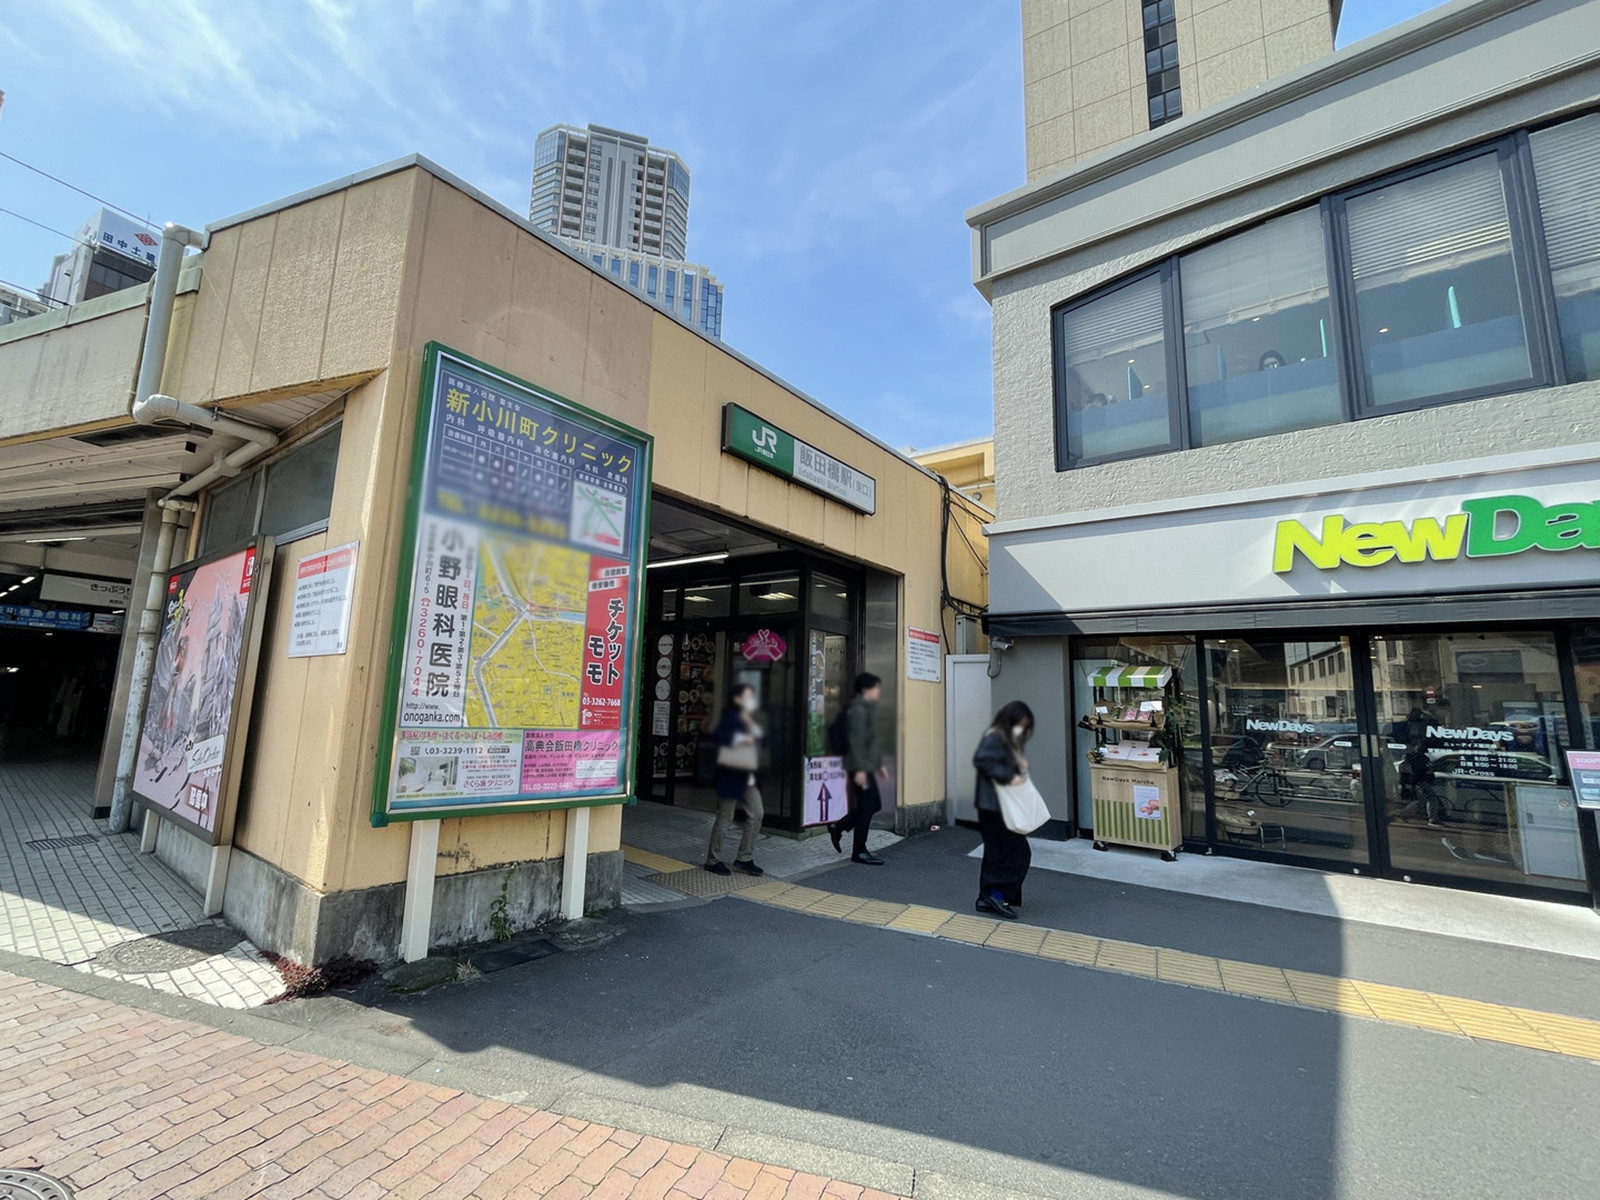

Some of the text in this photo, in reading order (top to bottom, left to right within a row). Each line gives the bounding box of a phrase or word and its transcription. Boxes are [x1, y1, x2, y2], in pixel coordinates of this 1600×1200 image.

[446, 414, 465, 428] 内科
[446, 388, 632, 473] 新小川町クリニック
[752, 426, 777, 453] JR
[754, 446, 774, 459] JR東日本
[426, 528, 464, 697] 小野眼科医院
[606, 598, 624, 685] チケット
[411, 608, 428, 697] 3260-7044
[586, 635, 605, 685] モモ
[582, 697, 621, 706] 03-3262-7668
[404, 711, 460, 724] onoganka.com
[1246, 719, 1315, 733] NewDays
[1426, 725, 1514, 742] NewDays
[429, 747, 483, 755] 03-3239-1112
[1452, 769, 1495, 777] JR-Cross
